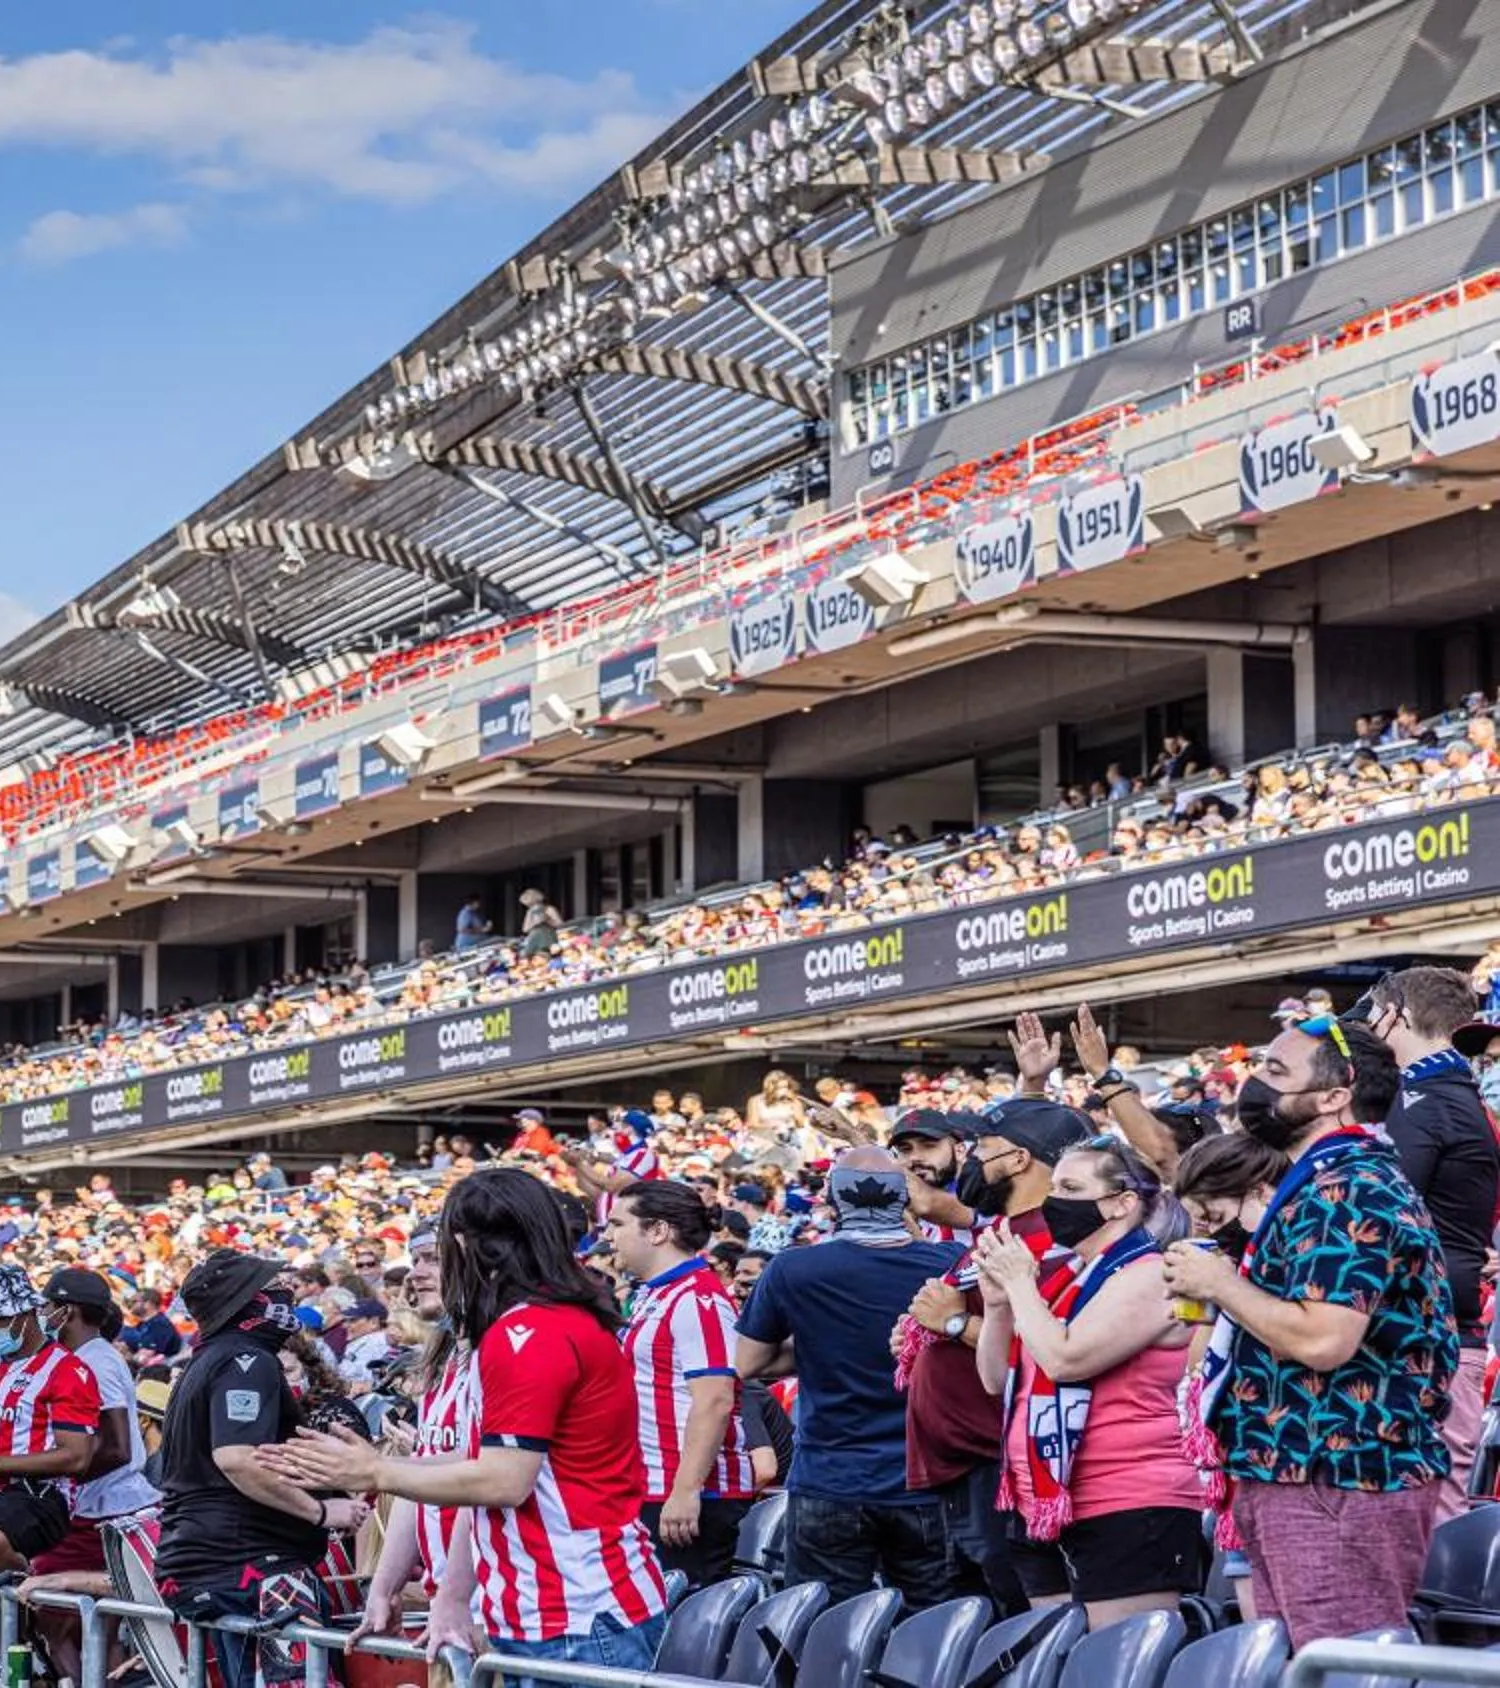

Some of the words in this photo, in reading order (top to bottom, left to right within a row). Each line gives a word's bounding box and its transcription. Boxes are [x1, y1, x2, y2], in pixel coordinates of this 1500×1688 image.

[1228, 306, 1252, 330] RR
[1433, 374, 1497, 429] 1968
[1076, 500, 1121, 547] 1951
[971, 535, 1017, 582] 1940
[819, 591, 859, 629] 1926
[743, 615, 782, 655] 1925
[511, 700, 529, 736] 72
[1323, 813, 1470, 879] comeon!
[1127, 856, 1254, 918] comeon!
[1325, 882, 1365, 909] Sports
[1368, 875, 1414, 901] Betting
[1423, 866, 1470, 889] Casino
[956, 895, 1068, 950] comeon!
[1128, 922, 1163, 945] Sports
[1165, 915, 1205, 940] Betting
[1213, 906, 1254, 929] Casino
[804, 928, 904, 980] comeon!
[957, 956, 987, 978] Sports
[989, 949, 1025, 972] Betting
[1031, 940, 1068, 959] Casino
[669, 958, 758, 1005] comeon!
[548, 985, 628, 1028] comeon!
[339, 1030, 405, 1069] comeon!
[438, 1008, 511, 1050] comeon!
[250, 1048, 309, 1085] comeon!
